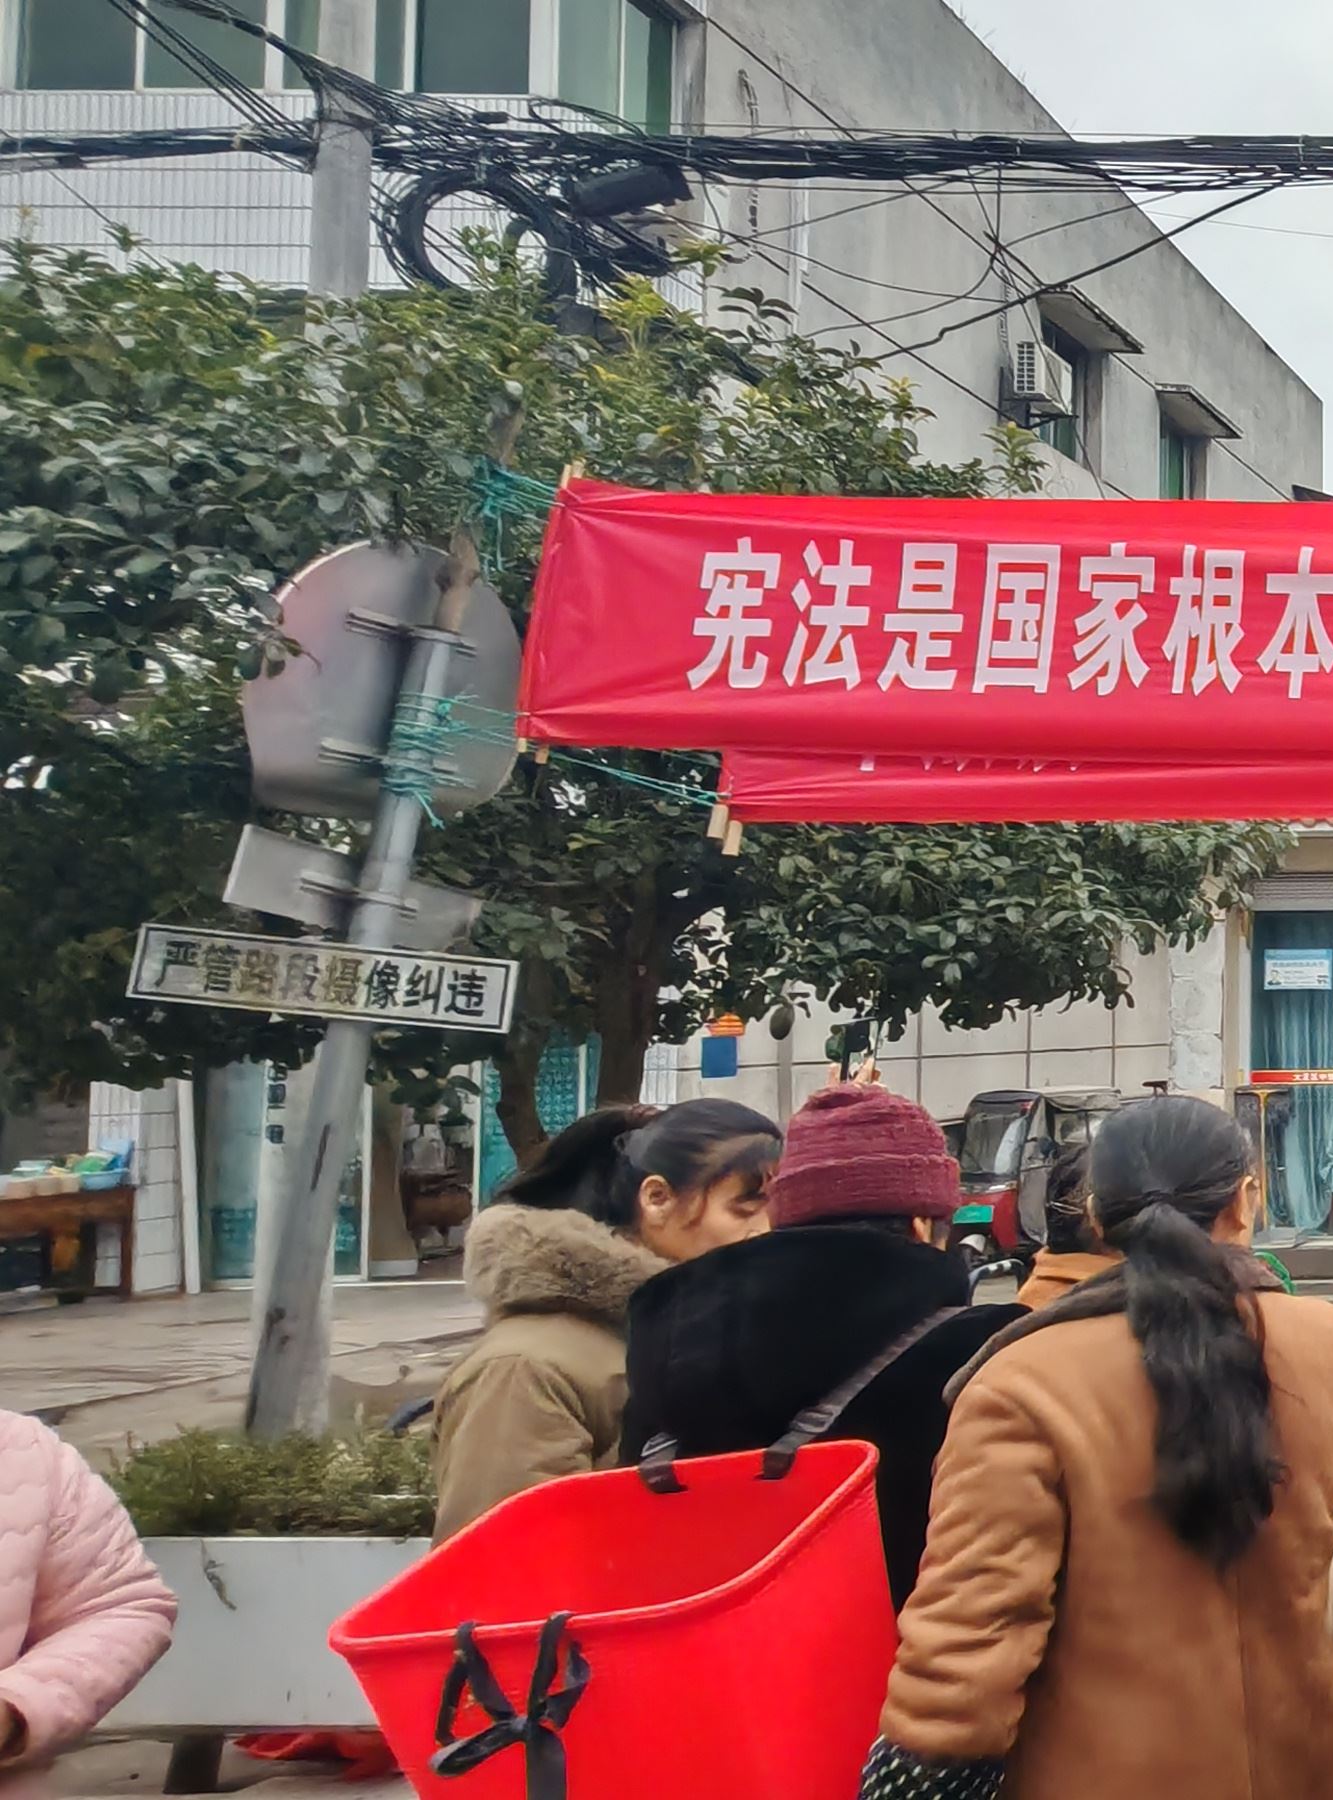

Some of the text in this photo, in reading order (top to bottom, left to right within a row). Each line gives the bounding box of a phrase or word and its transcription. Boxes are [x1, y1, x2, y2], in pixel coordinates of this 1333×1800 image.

[153, 939, 488, 1018] 严管路段摄像纠违
